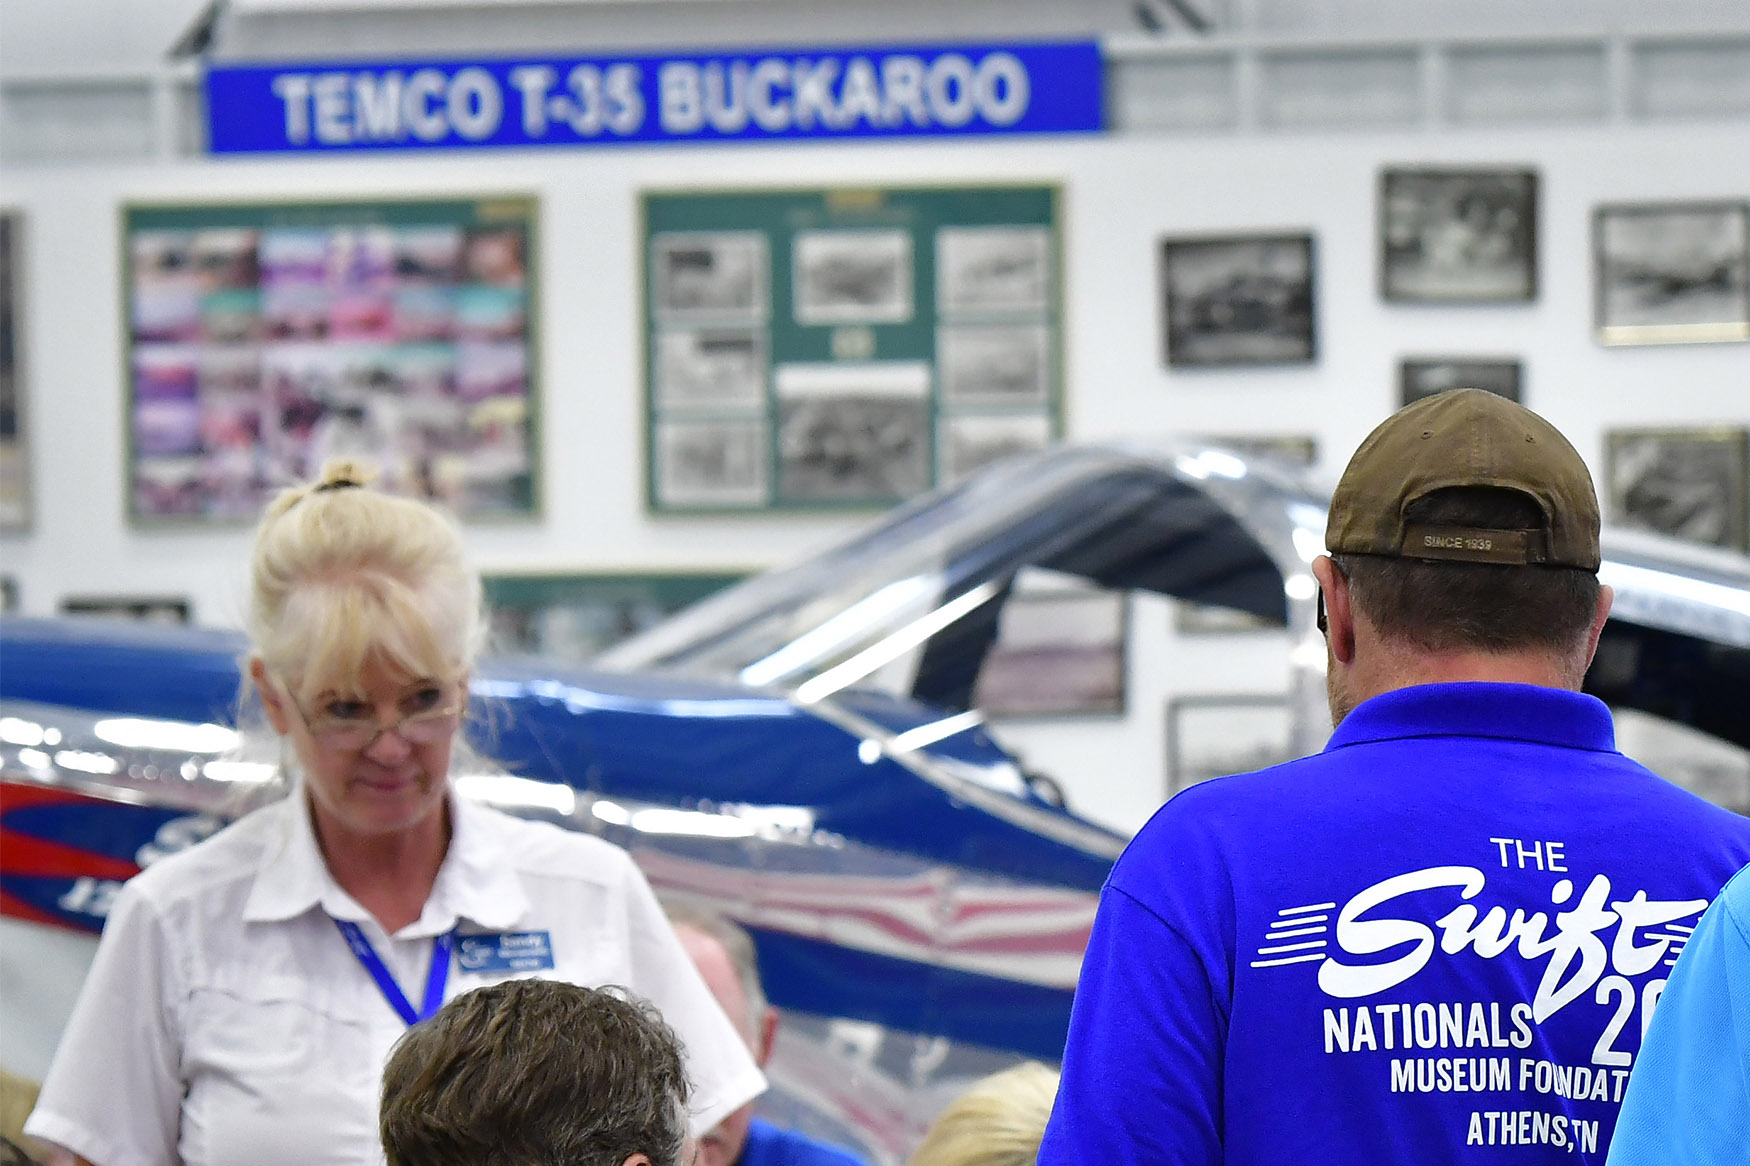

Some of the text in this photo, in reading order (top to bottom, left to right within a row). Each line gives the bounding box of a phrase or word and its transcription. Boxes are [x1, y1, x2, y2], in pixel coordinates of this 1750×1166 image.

[274, 52, 1031, 145] TEMCO T-35 BUCKAROO
[1423, 535, 1492, 551] SINCE 1939
[1489, 837, 1569, 873] THE
[1317, 865, 1709, 1026] Swift
[1322, 1001, 1533, 1054] NATIONALS
[1390, 1057, 1633, 1103] MUSEUM FOUNDAT
